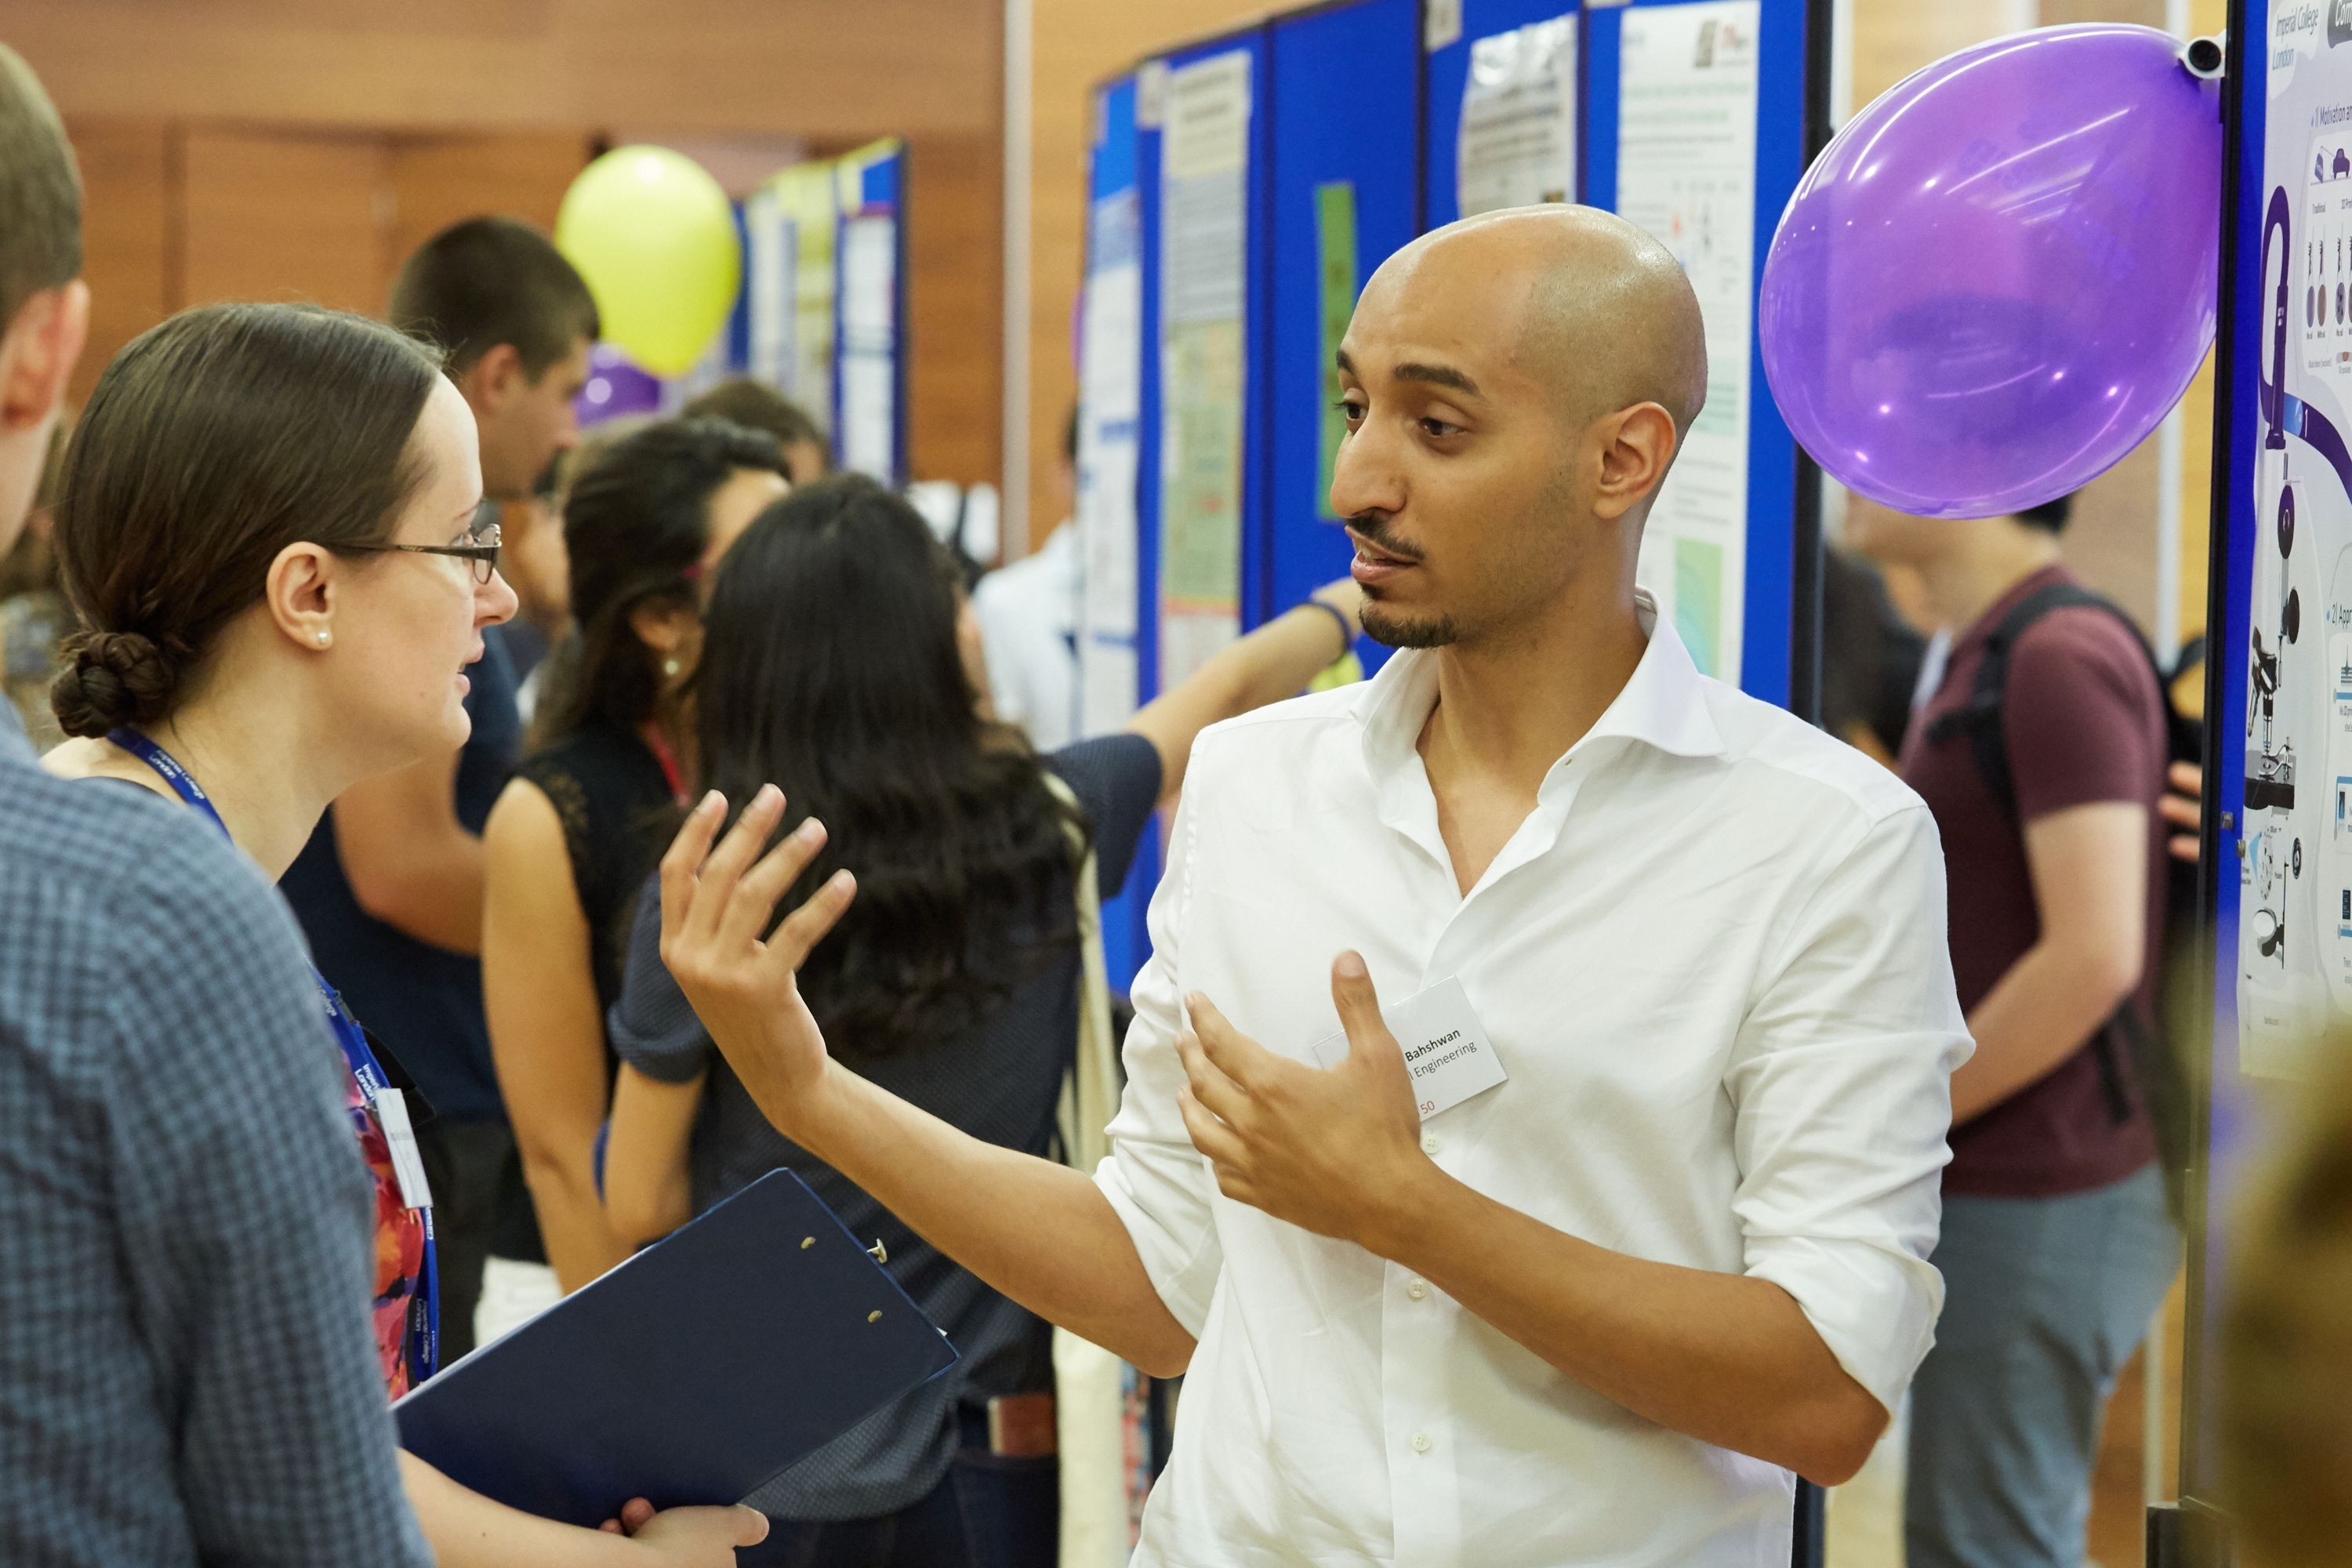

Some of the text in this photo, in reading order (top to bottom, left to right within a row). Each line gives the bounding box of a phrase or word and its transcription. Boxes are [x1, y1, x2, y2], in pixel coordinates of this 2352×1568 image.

[2275, 3, 2319, 44] Imperial College
[2272, 45, 2294, 71] London
[2320, 102, 2345, 126] Motivation
[1405, 1029, 1461, 1062] Bahshwan
[1414, 1041, 1478, 1078] Engineering
[362, 1063, 380, 1090] Imperi
[1420, 1100, 1436, 1114] 50
